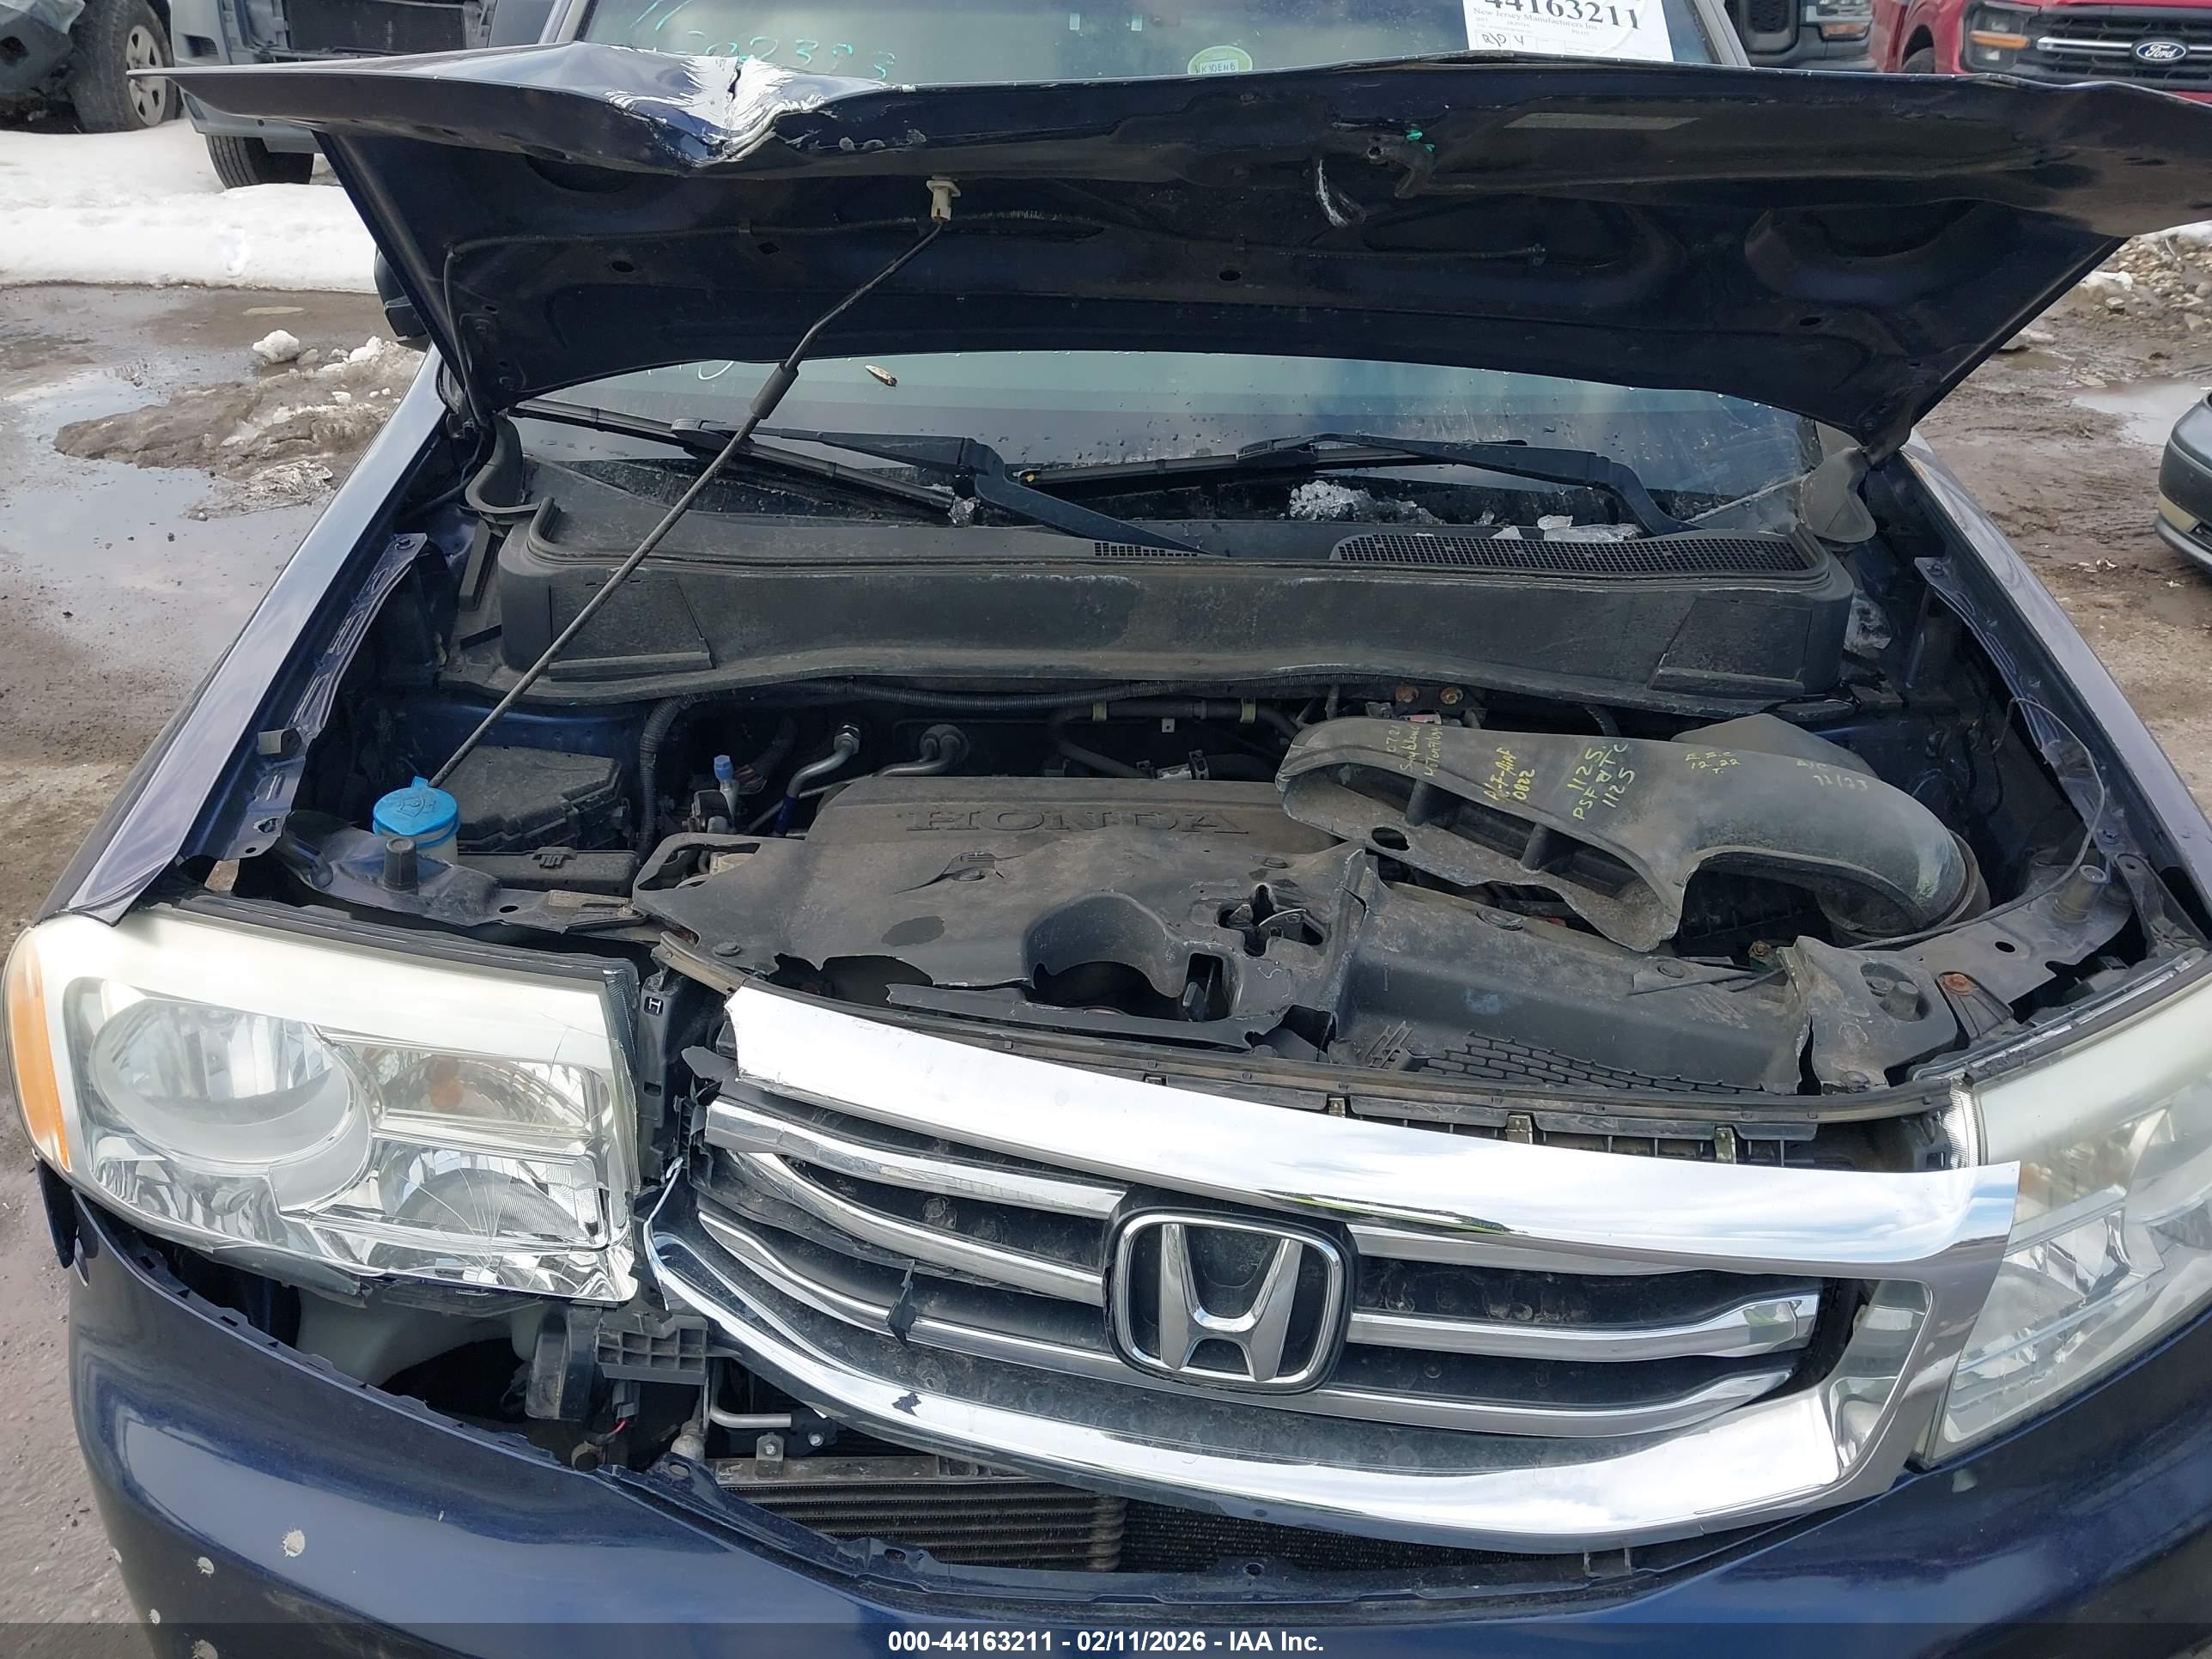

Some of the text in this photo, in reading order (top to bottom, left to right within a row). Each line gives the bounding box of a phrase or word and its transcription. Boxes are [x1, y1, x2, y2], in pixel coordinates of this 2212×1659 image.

[1474, 7, 1493, 15] New
[1496, 9, 1521, 21] Jersey
[2144, 44, 2179, 58] Ford
[906, 810, 1250, 836] HONDA
